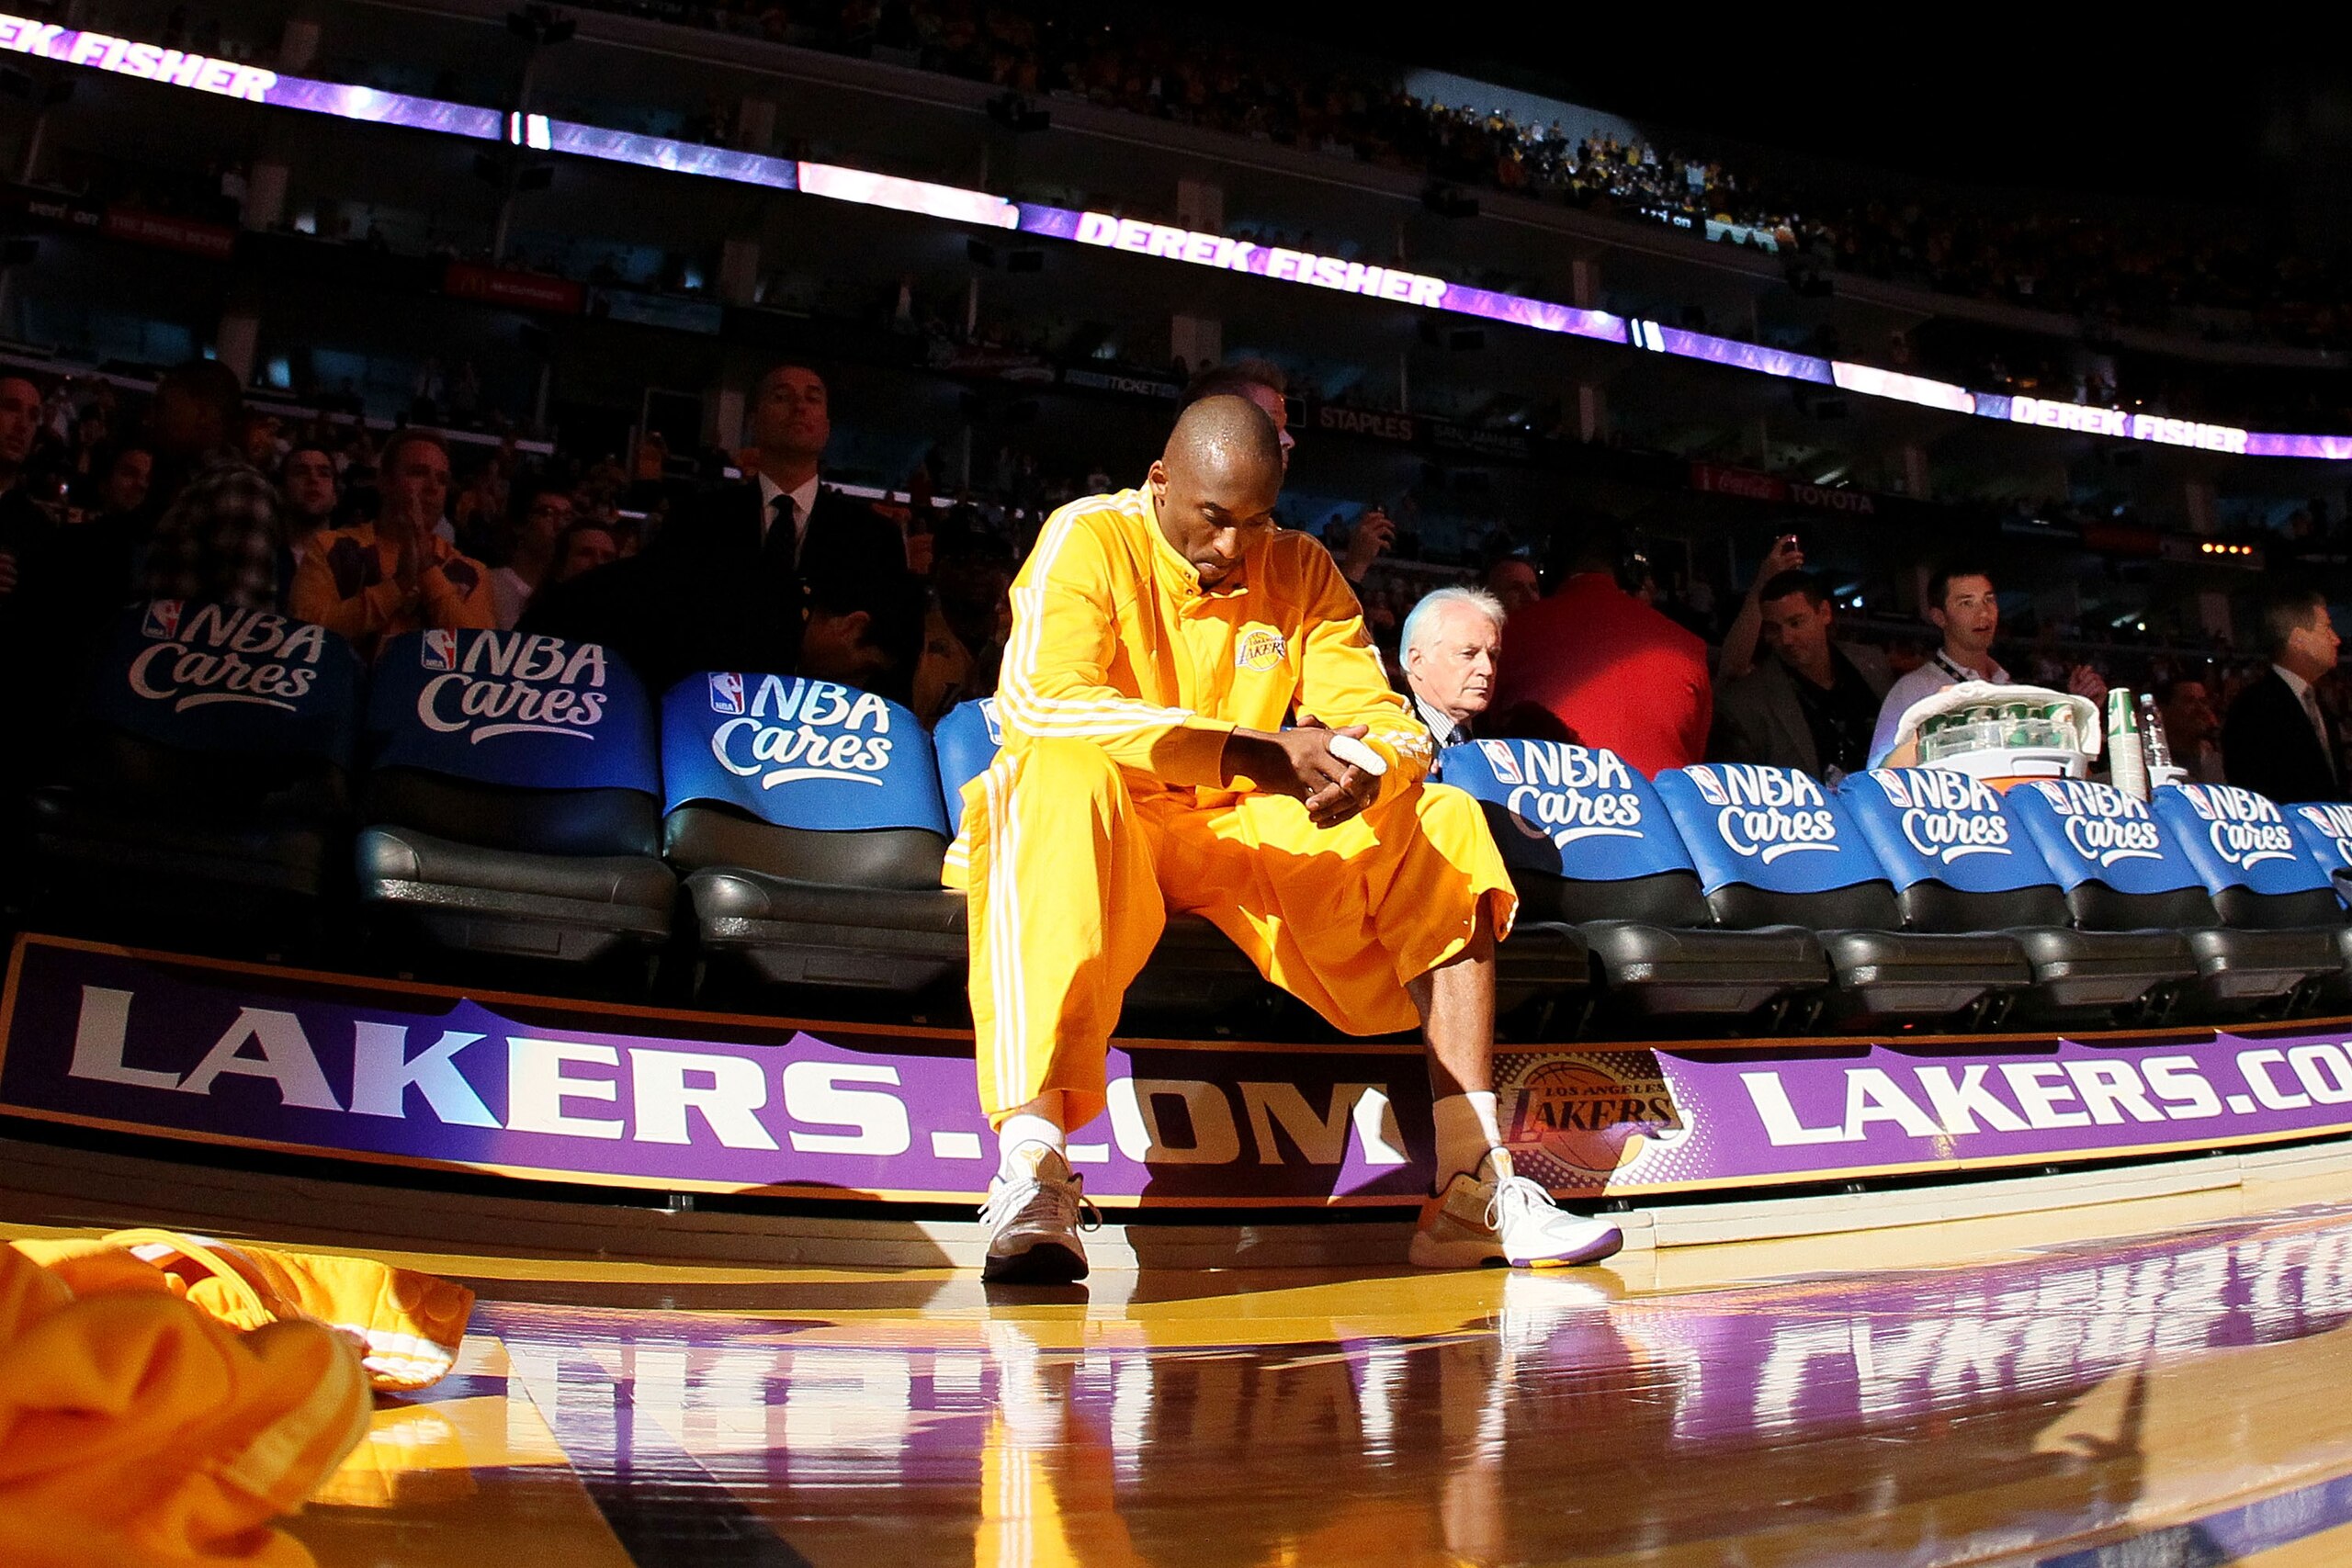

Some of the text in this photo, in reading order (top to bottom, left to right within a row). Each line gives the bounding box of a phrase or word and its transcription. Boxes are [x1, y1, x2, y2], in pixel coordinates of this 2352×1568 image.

[69, 31, 277, 103] FISHER
[1076, 210, 1447, 309] DEREK FISHER
[1319, 406, 1414, 441] STAPLES
[2010, 395, 2247, 454] DEREK FISHER
[1789, 483, 1874, 514] TOYOTA
[180, 603, 327, 664] NBA
[462, 630, 608, 688] NBA
[128, 643, 319, 701] Cares
[417, 673, 607, 733] Cares
[751, 674, 890, 733] NBA
[712, 717, 893, 776] Cares
[1521, 739, 1633, 790] NBA
[1508, 785, 1642, 840] Cares
[1722, 764, 1825, 807] NBA
[1907, 769, 1999, 812] NBA
[2066, 781, 2149, 819] NBA
[2205, 784, 2283, 823] NBA
[1718, 806, 1836, 856] Cares
[1902, 808, 2009, 856] Cares
[2064, 815, 2160, 860] Cares
[2210, 819, 2293, 863] Cares
[68, 984, 1411, 1165] LAKERS.OM
[1545, 1082, 1667, 1096] LOS ANGELES
[1739, 1040, 2352, 1147] LAKERS.CO
[1508, 1088, 1674, 1144] LAKERS
